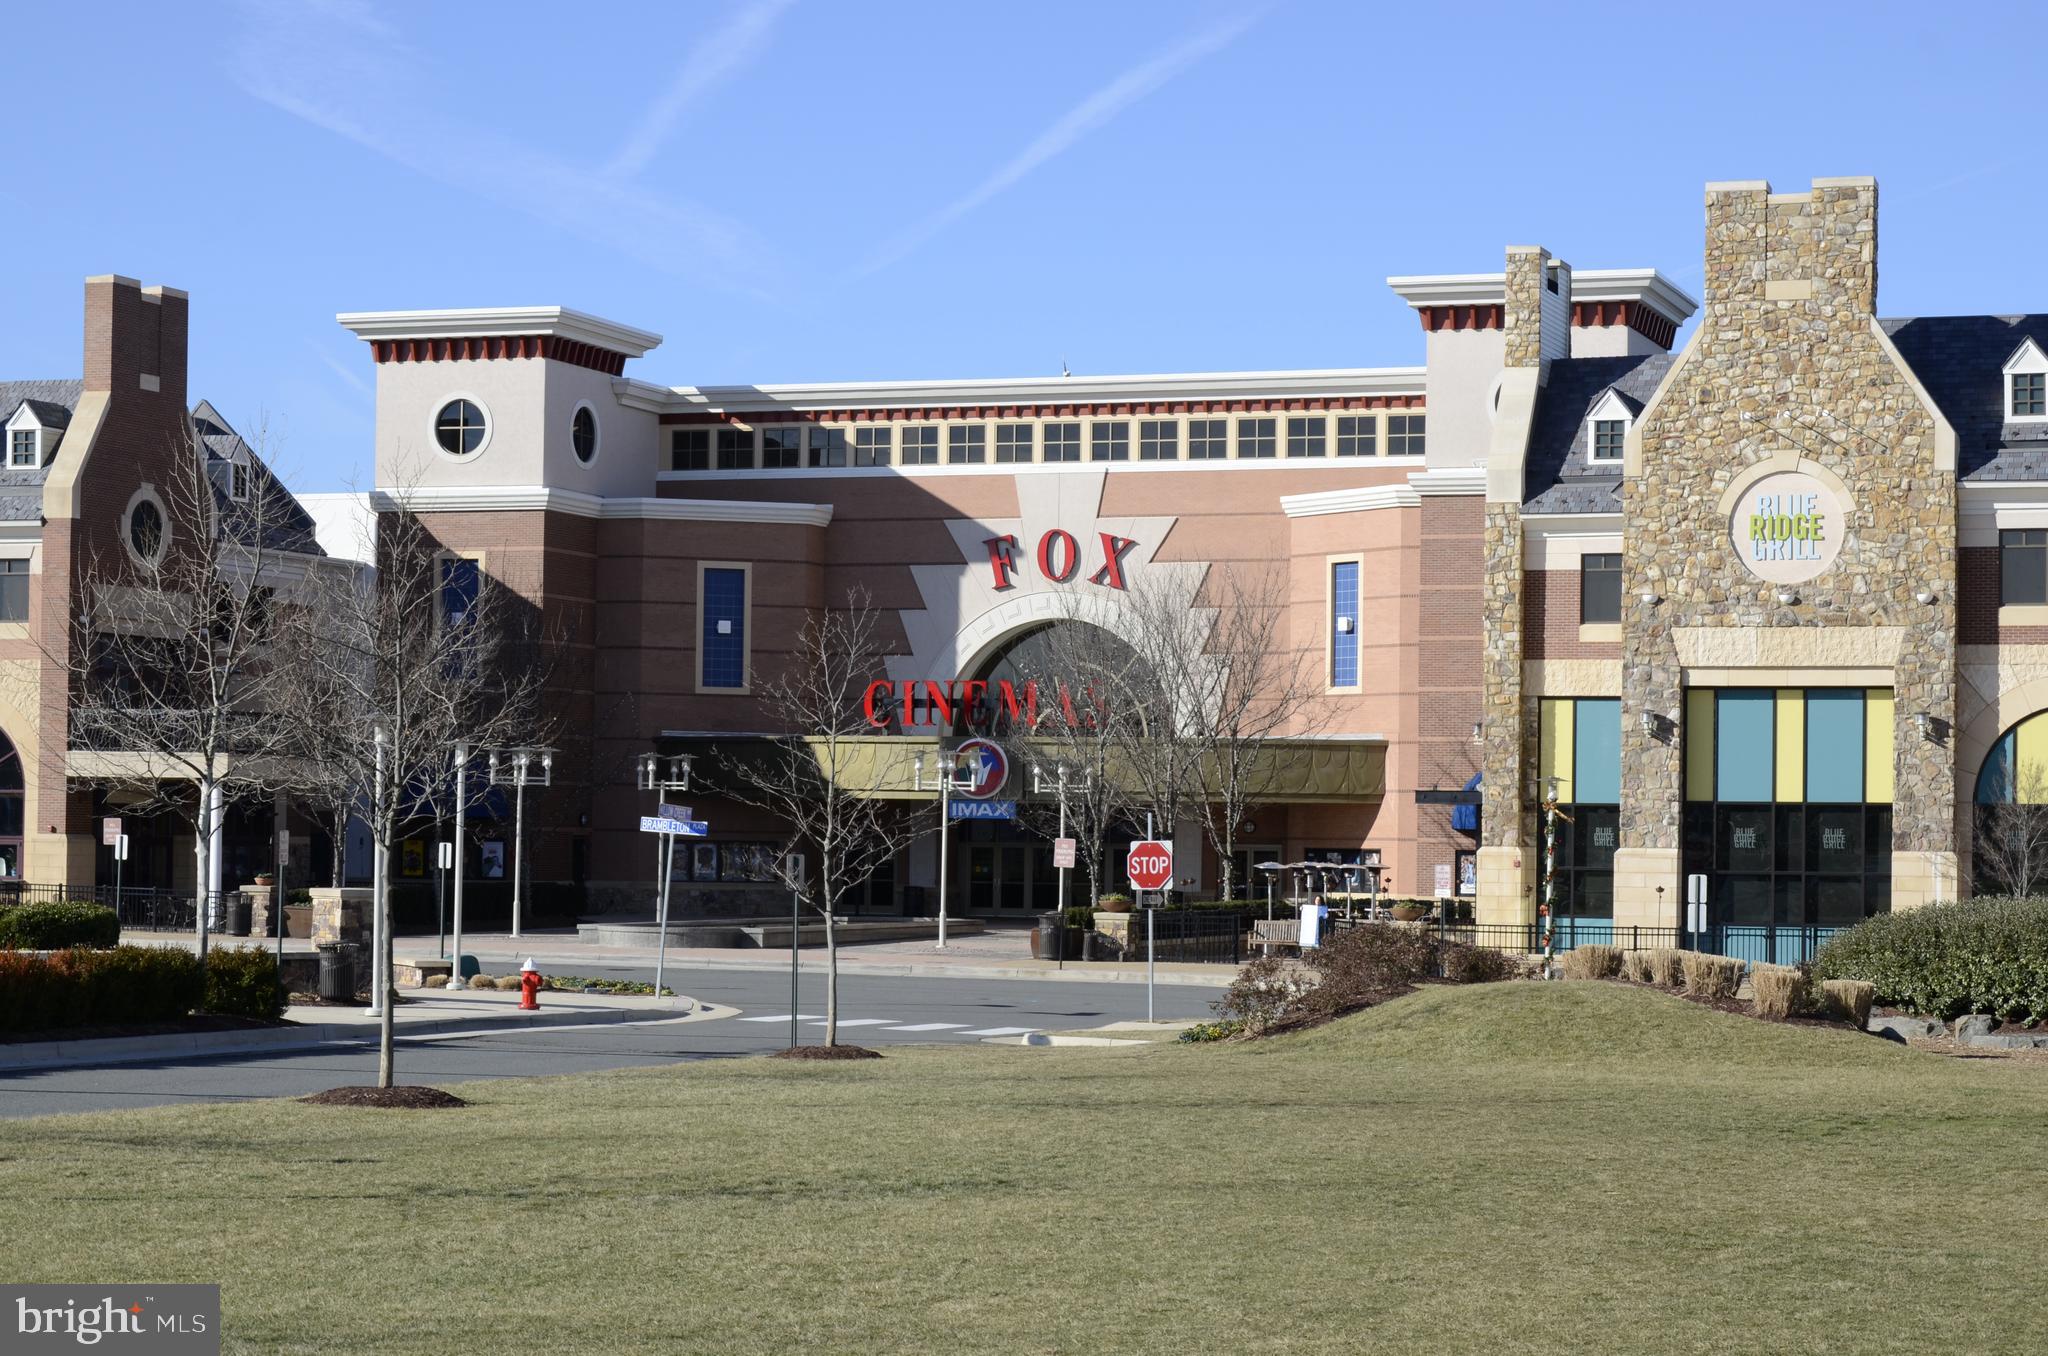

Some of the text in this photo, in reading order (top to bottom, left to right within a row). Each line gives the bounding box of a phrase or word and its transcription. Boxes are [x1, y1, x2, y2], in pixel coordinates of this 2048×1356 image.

[1757, 493, 1818, 518] BLUE
[1750, 514, 1825, 541] RIDGE
[982, 528, 1138, 591] FOX
[1751, 537, 1821, 561] GRILL
[952, 803, 1009, 817] IMAX
[642, 819, 690, 833] BRAMBLETON
[1131, 856, 1169, 875] STOP
